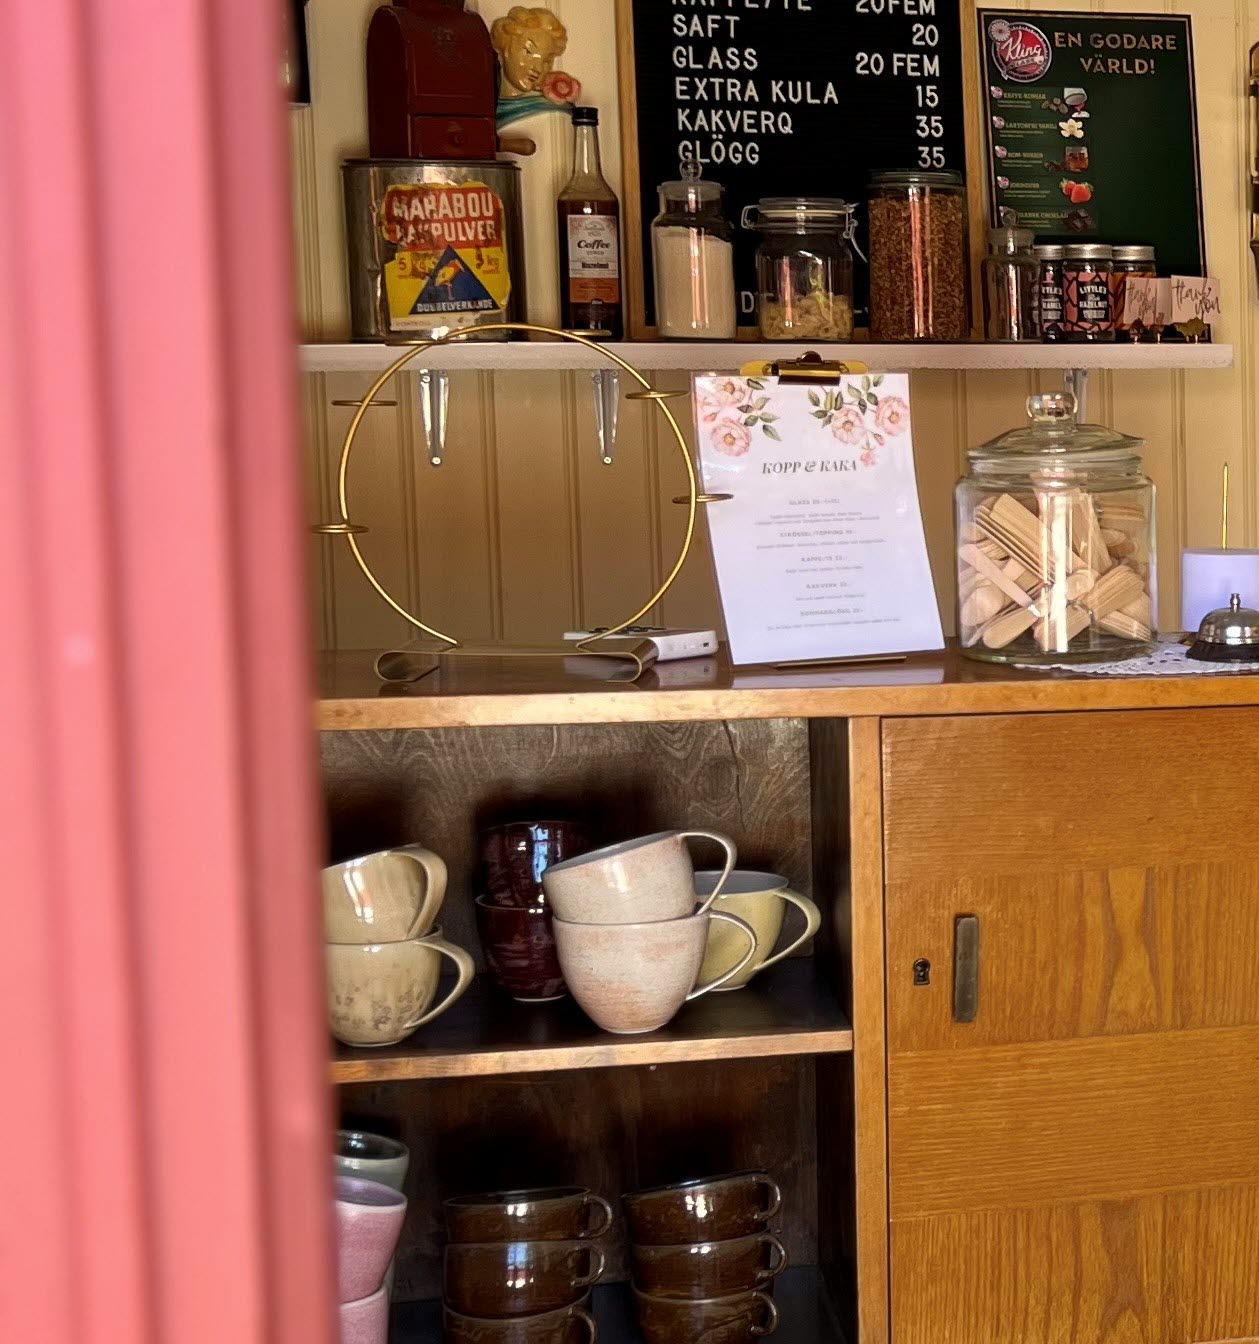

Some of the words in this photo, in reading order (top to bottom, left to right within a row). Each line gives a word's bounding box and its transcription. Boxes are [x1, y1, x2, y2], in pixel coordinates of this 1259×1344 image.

[672, 14, 740, 39] SAFT
[912, 24, 939, 47] 20
[1054, 32, 1083, 48] EN
[1089, 33, 1177, 50] GODARE
[672, 46, 758, 71] GLASS
[855, 52, 884, 75] 20
[892, 53, 940, 77] FEM
[1079, 53, 1155, 75] VÄRLD!
[675, 77, 759, 102] EXTRA
[771, 80, 839, 105] KULA
[916, 85, 939, 108] 15
[677, 108, 794, 135] KAKVERQ
[916, 115, 944, 138] 35
[678, 134, 760, 165] GLÖGG
[917, 146, 946, 169] 35
[577, 239, 611, 249] Coffee
[762, 461, 802, 474] KOPP
[804, 460, 817, 473] &
[820, 459, 857, 472] KAKA
